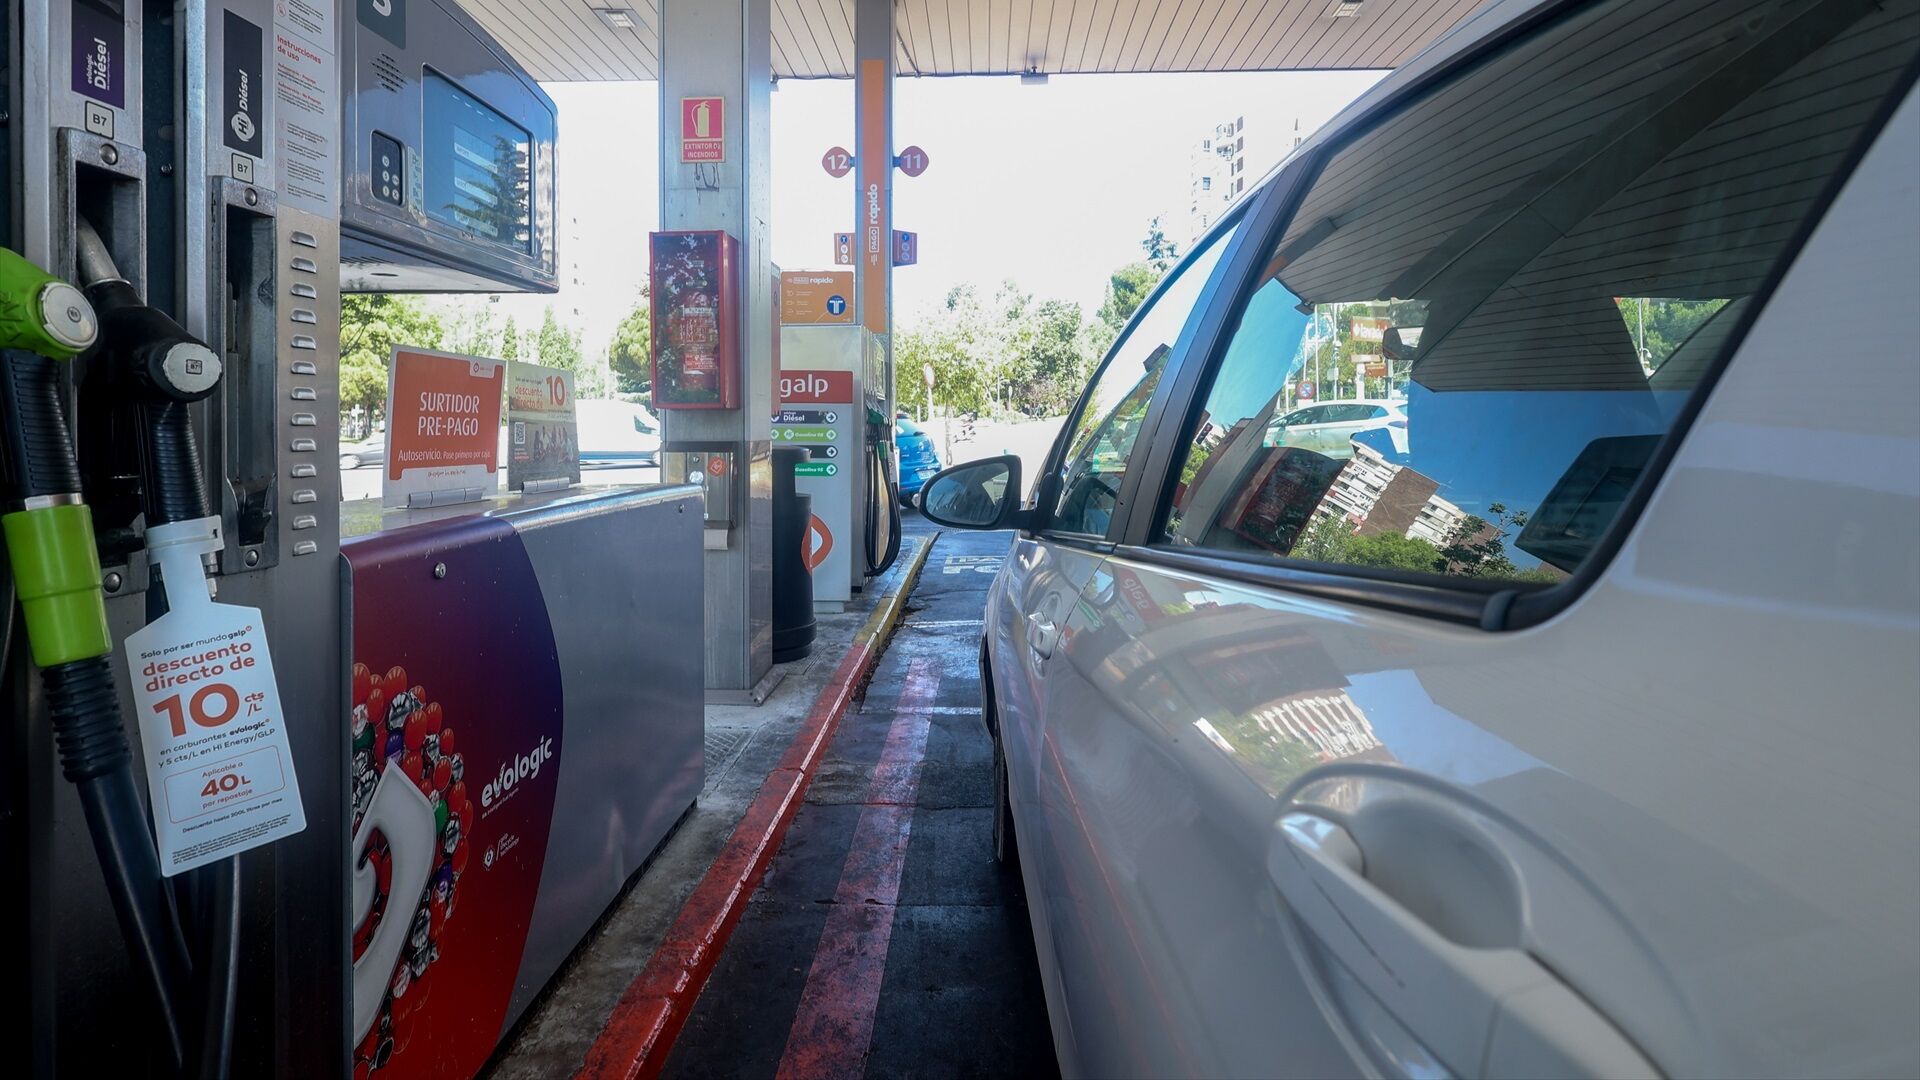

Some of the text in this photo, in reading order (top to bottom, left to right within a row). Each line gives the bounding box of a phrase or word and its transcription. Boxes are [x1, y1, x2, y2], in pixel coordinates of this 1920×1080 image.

[277, 34, 322, 64] Instrucciones
[278, 46, 300, 62] de uso
[94, 37, 107, 90] Diésel
[239, 69, 248, 135] Hi Diésel
[92, 113, 107, 126] B7
[237, 163, 248, 174] B7
[828, 154, 848, 170] 12
[903, 154, 920, 169] 11
[546, 375, 565, 406] 10
[780, 374, 828, 398] galp
[420, 392, 480, 414] SURTIDOR
[418, 416, 479, 436] PRE-PAGO
[398, 448, 442, 461] Autoservicio.
[141, 650, 161, 659] Solo
[163, 646, 178, 655] por
[196, 630, 246, 646] mundogalp
[143, 642, 252, 676] descuento
[146, 656, 255, 692] directo de
[153, 683, 264, 737] 10 cts
[248, 703, 262, 717] /L
[173, 732, 226, 752] carburantes
[174, 752, 199, 763] cts/L
[224, 728, 276, 748] Energy/GLP
[202, 764, 237, 778] Aplicable
[482, 735, 552, 808] evologic
[201, 774, 251, 797] 40 L
[202, 788, 253, 809] por repostaje
